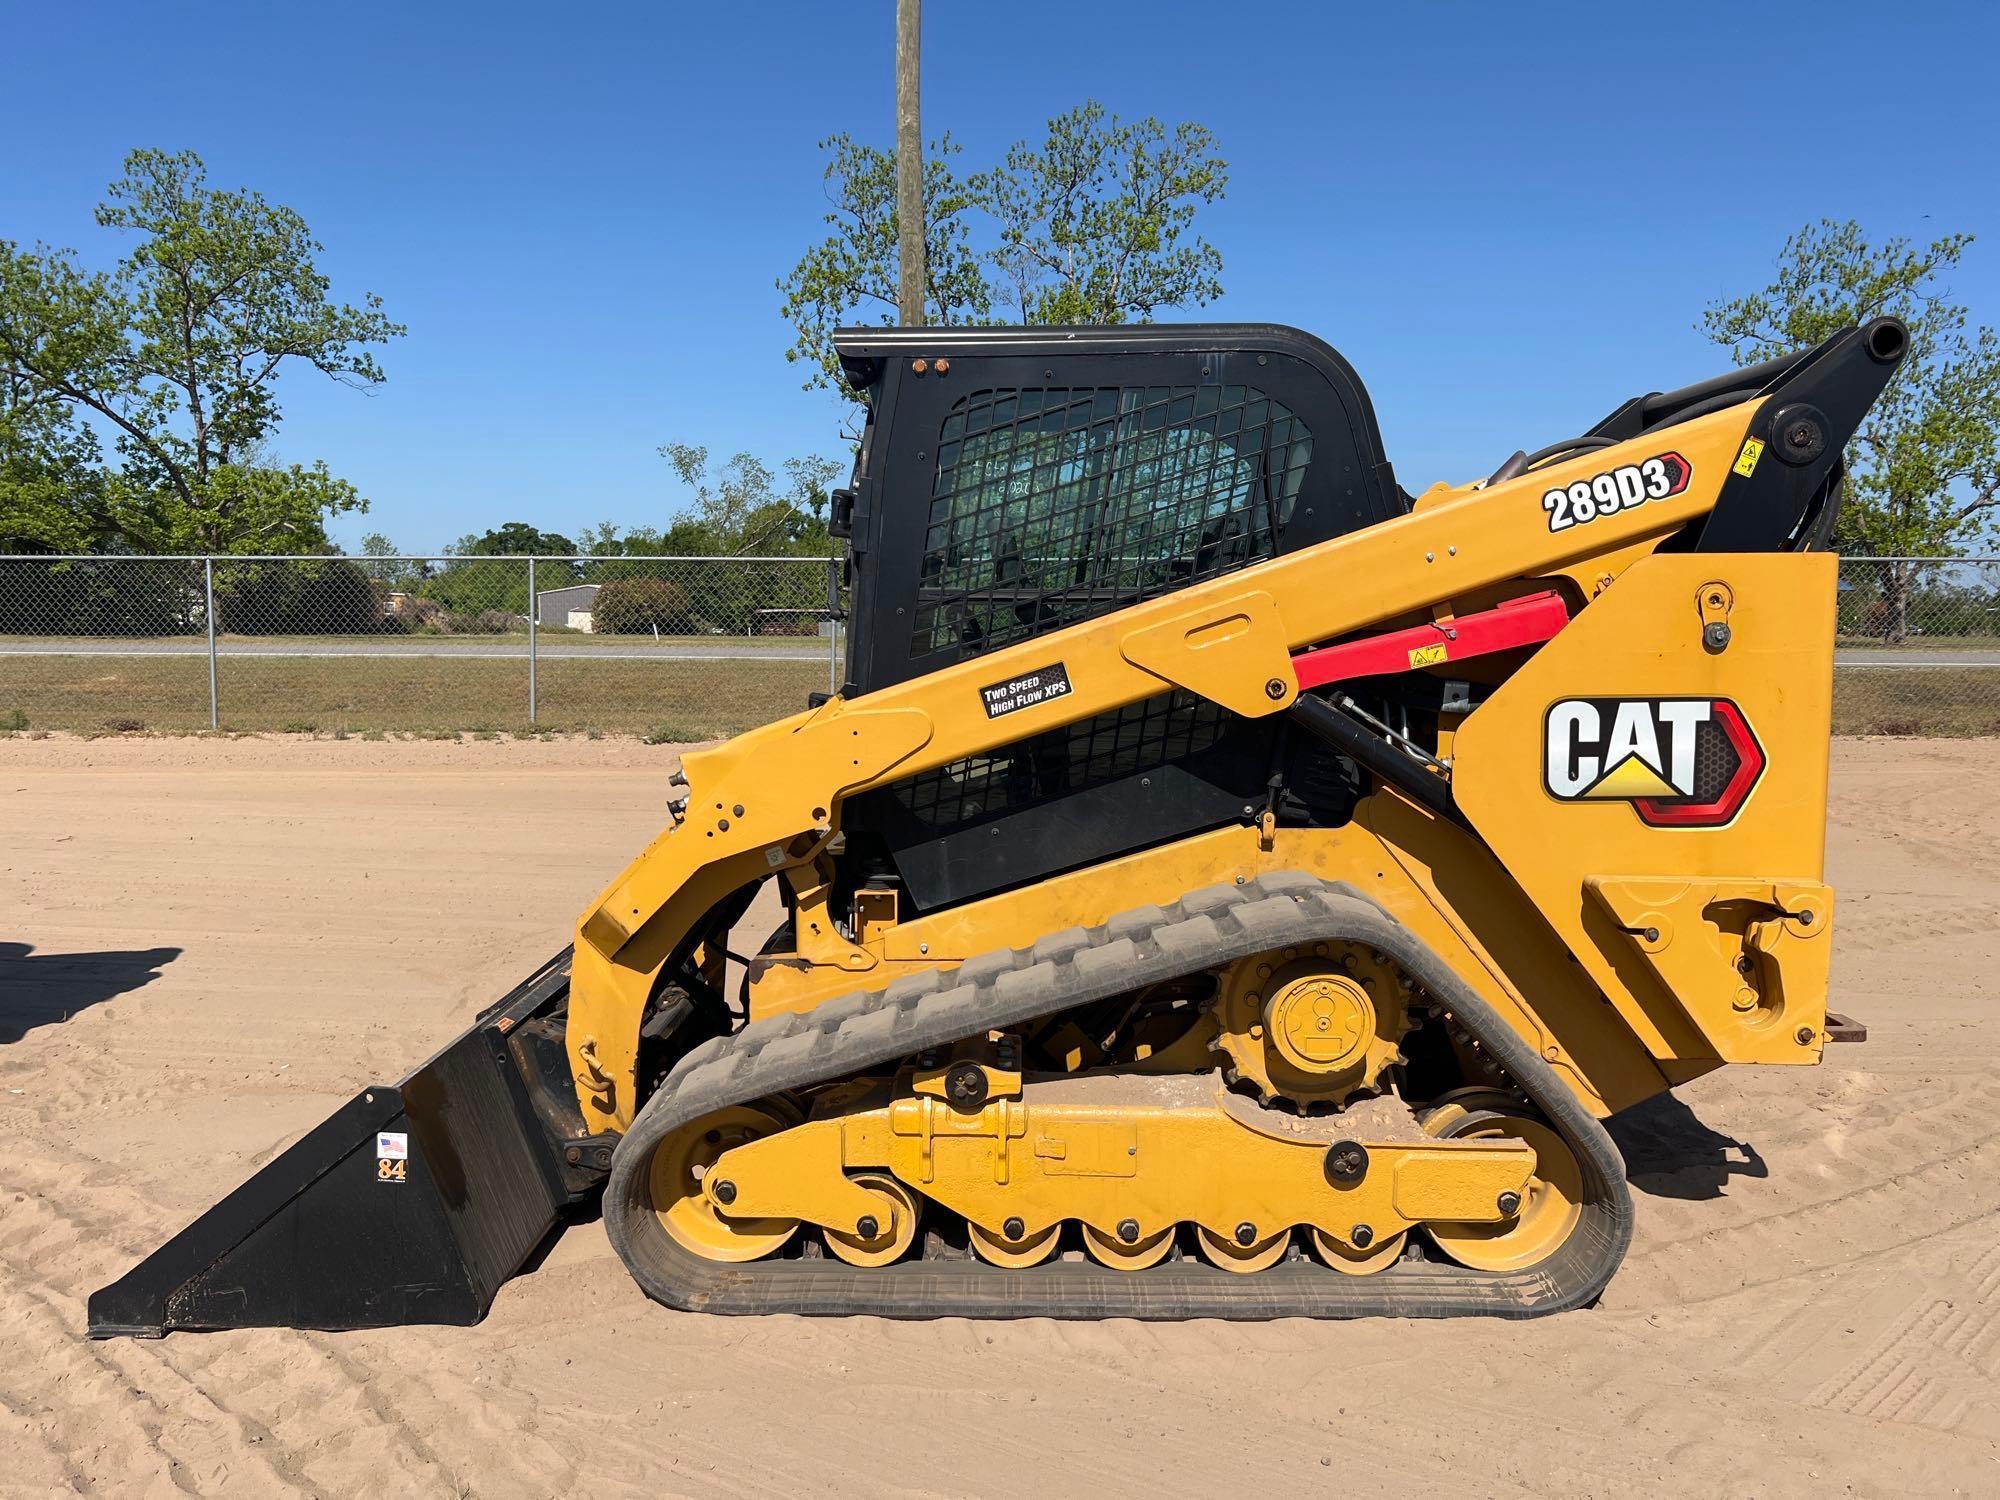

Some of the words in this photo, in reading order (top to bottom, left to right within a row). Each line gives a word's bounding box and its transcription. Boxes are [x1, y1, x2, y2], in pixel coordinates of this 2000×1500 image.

[1543, 458, 1671, 531] 289D3
[984, 687, 1007, 702] TWO
[1009, 676, 1040, 695] SPEED
[990, 699, 1015, 716] HIGH
[1016, 689, 1043, 707] FLOW
[1045, 680, 1067, 698] XPS
[1547, 700, 1711, 798] CAT
[378, 1158, 406, 1180] 84
